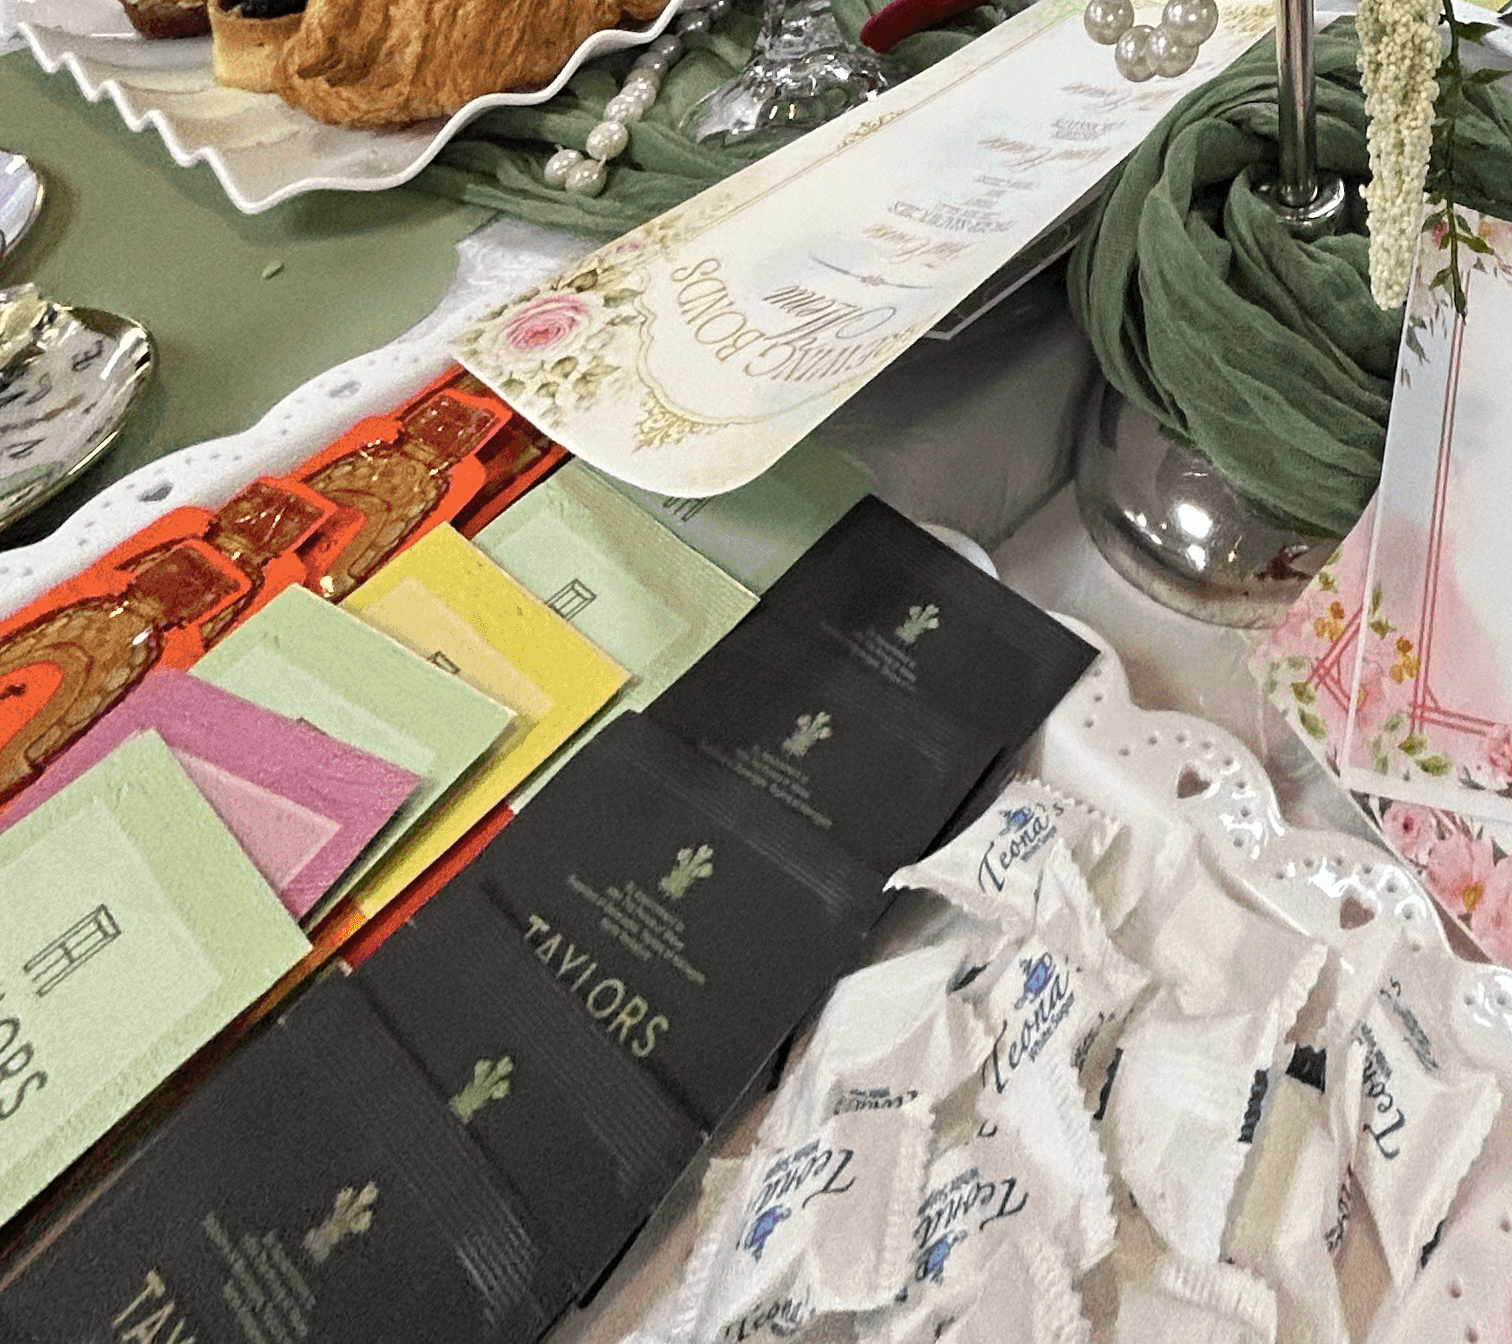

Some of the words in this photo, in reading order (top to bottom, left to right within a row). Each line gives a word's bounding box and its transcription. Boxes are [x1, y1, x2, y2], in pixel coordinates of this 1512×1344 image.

[671, 257, 766, 362] BONDS
[762, 284, 897, 346] Menu
[978, 801, 1064, 892] Teona's
